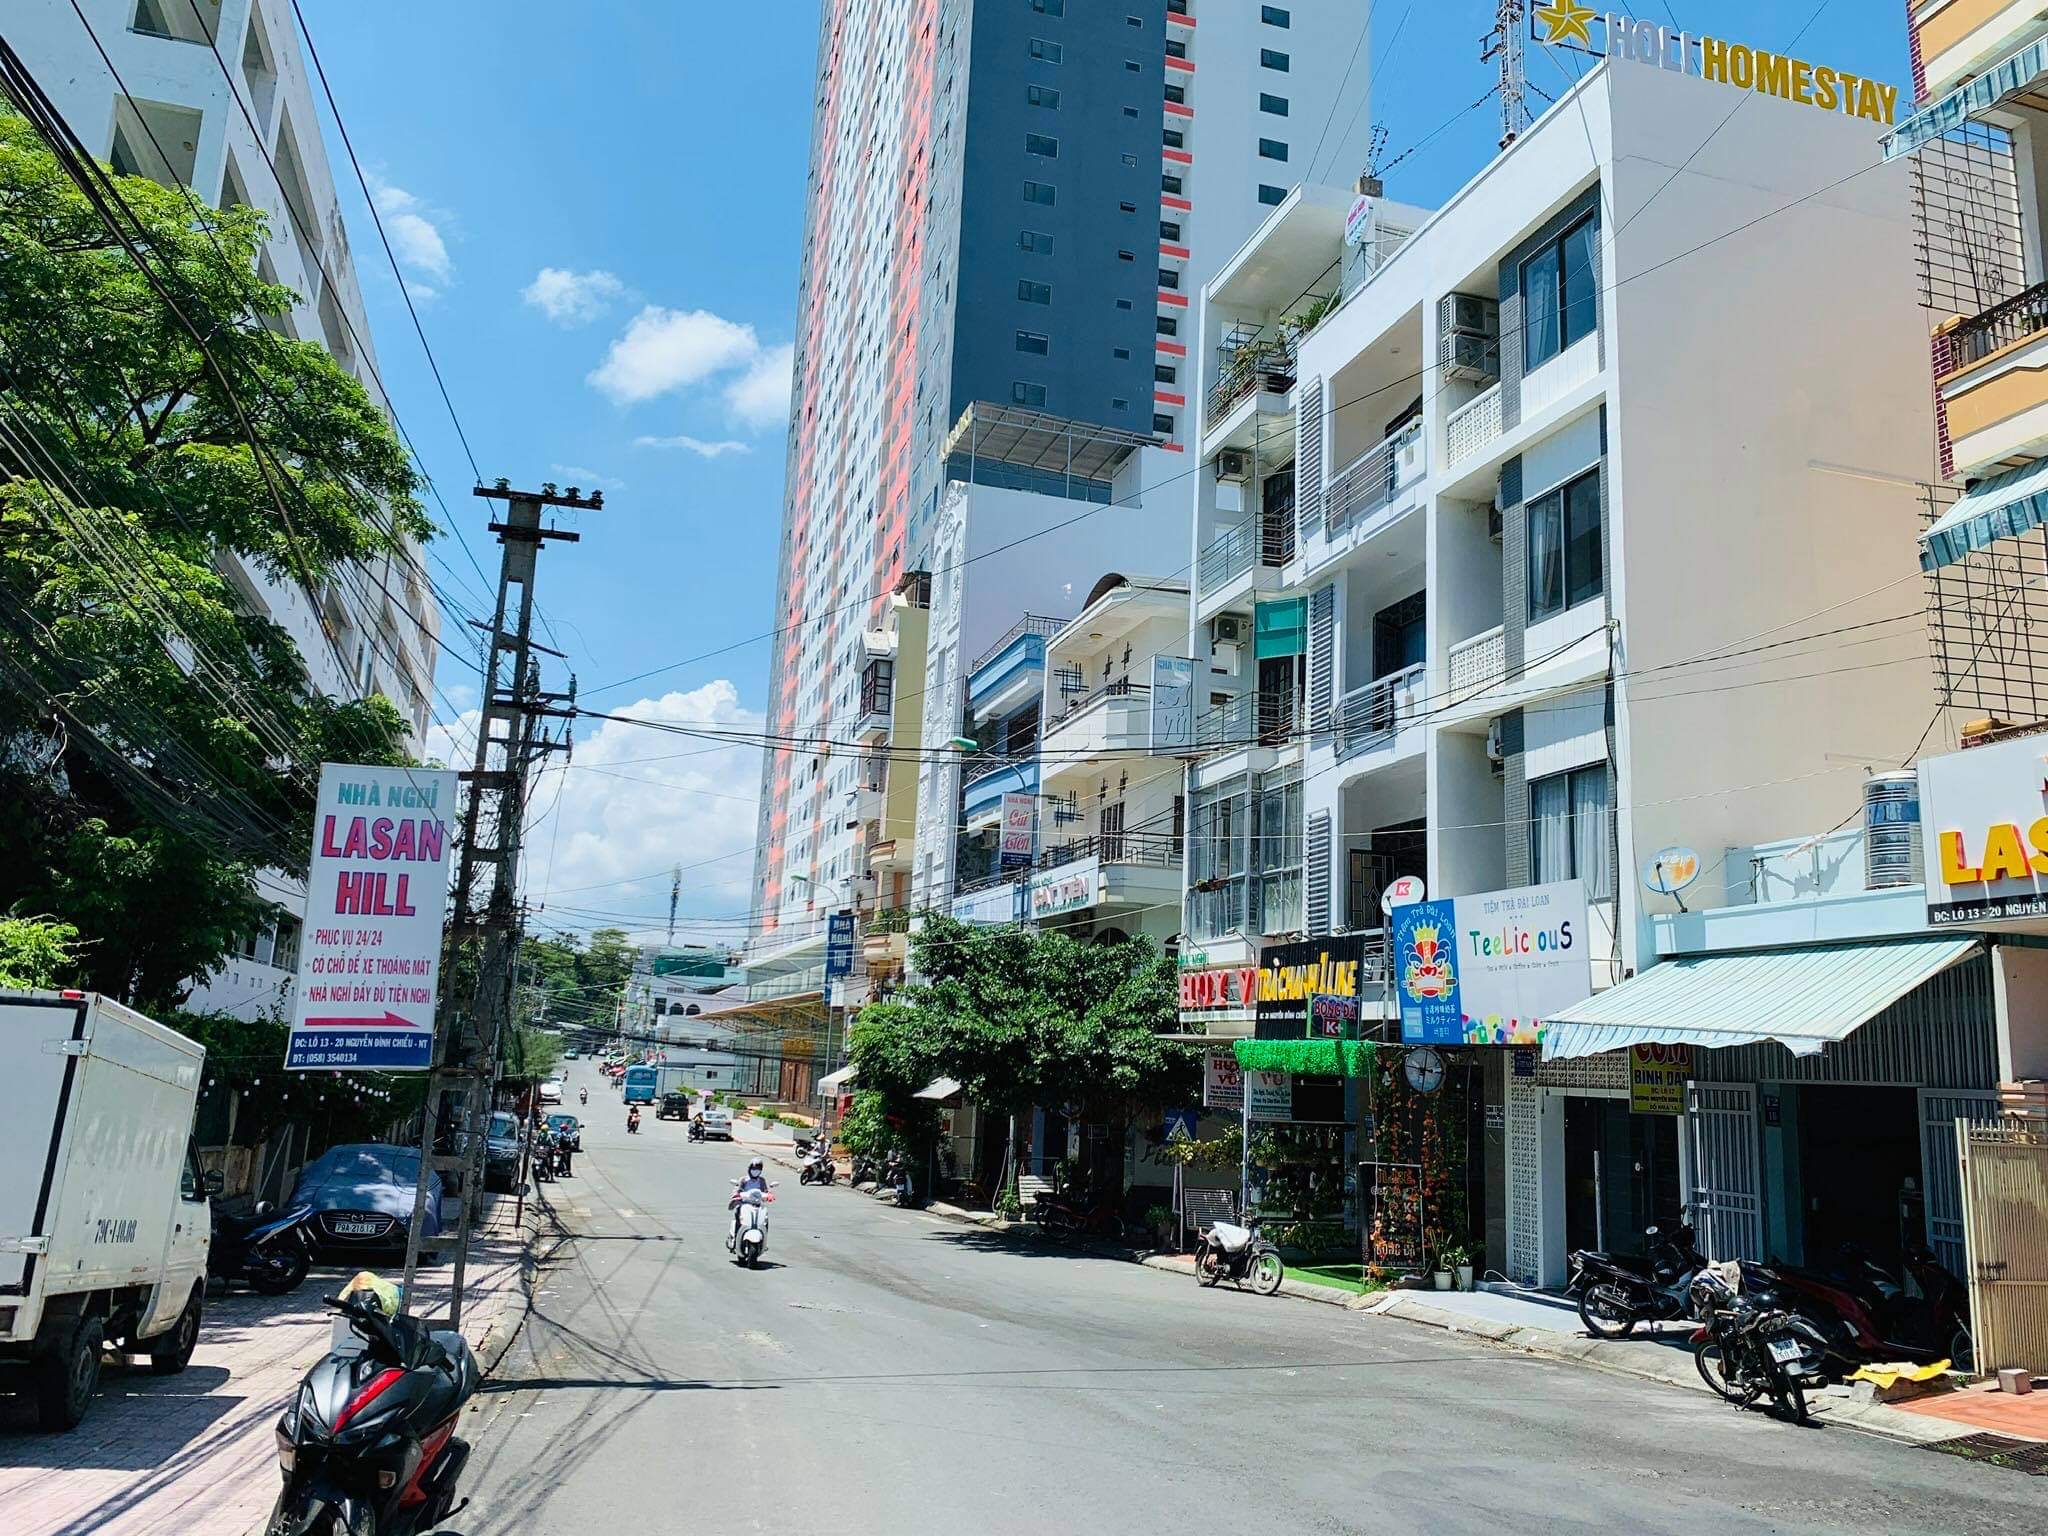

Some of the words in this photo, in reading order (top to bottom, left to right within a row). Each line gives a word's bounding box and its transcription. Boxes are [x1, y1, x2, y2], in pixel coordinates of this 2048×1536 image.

[1605, 11, 1698, 76] HOLI
[1700, 35, 1898, 126] HOMESTAY
[338, 779, 381, 807] NHÀ
[387, 778, 440, 809] NGHỈ
[320, 814, 445, 862] LASAN
[335, 870, 416, 917] HILL
[1531, 894, 1551, 908] LOAN
[1951, 908, 1965, 921] LÔ
[1967, 907, 1980, 919] 13
[1988, 905, 2002, 918] 20
[2005, 898, 2047, 917] NGUYỄN
[315, 929, 340, 949] PHỤC
[342, 930, 354, 949] VỤ
[355, 930, 383, 947] 24/24
[362, 958, 374, 974] XE
[308, 981, 328, 1003] NHÀ
[1178, 970, 1229, 1008] HUY
[1236, 966, 1259, 1006] V
[1425, 1015, 1457, 1025] ミルクティー
[320, 1038, 330, 1048] 13
[334, 1038, 345, 1048] 20
